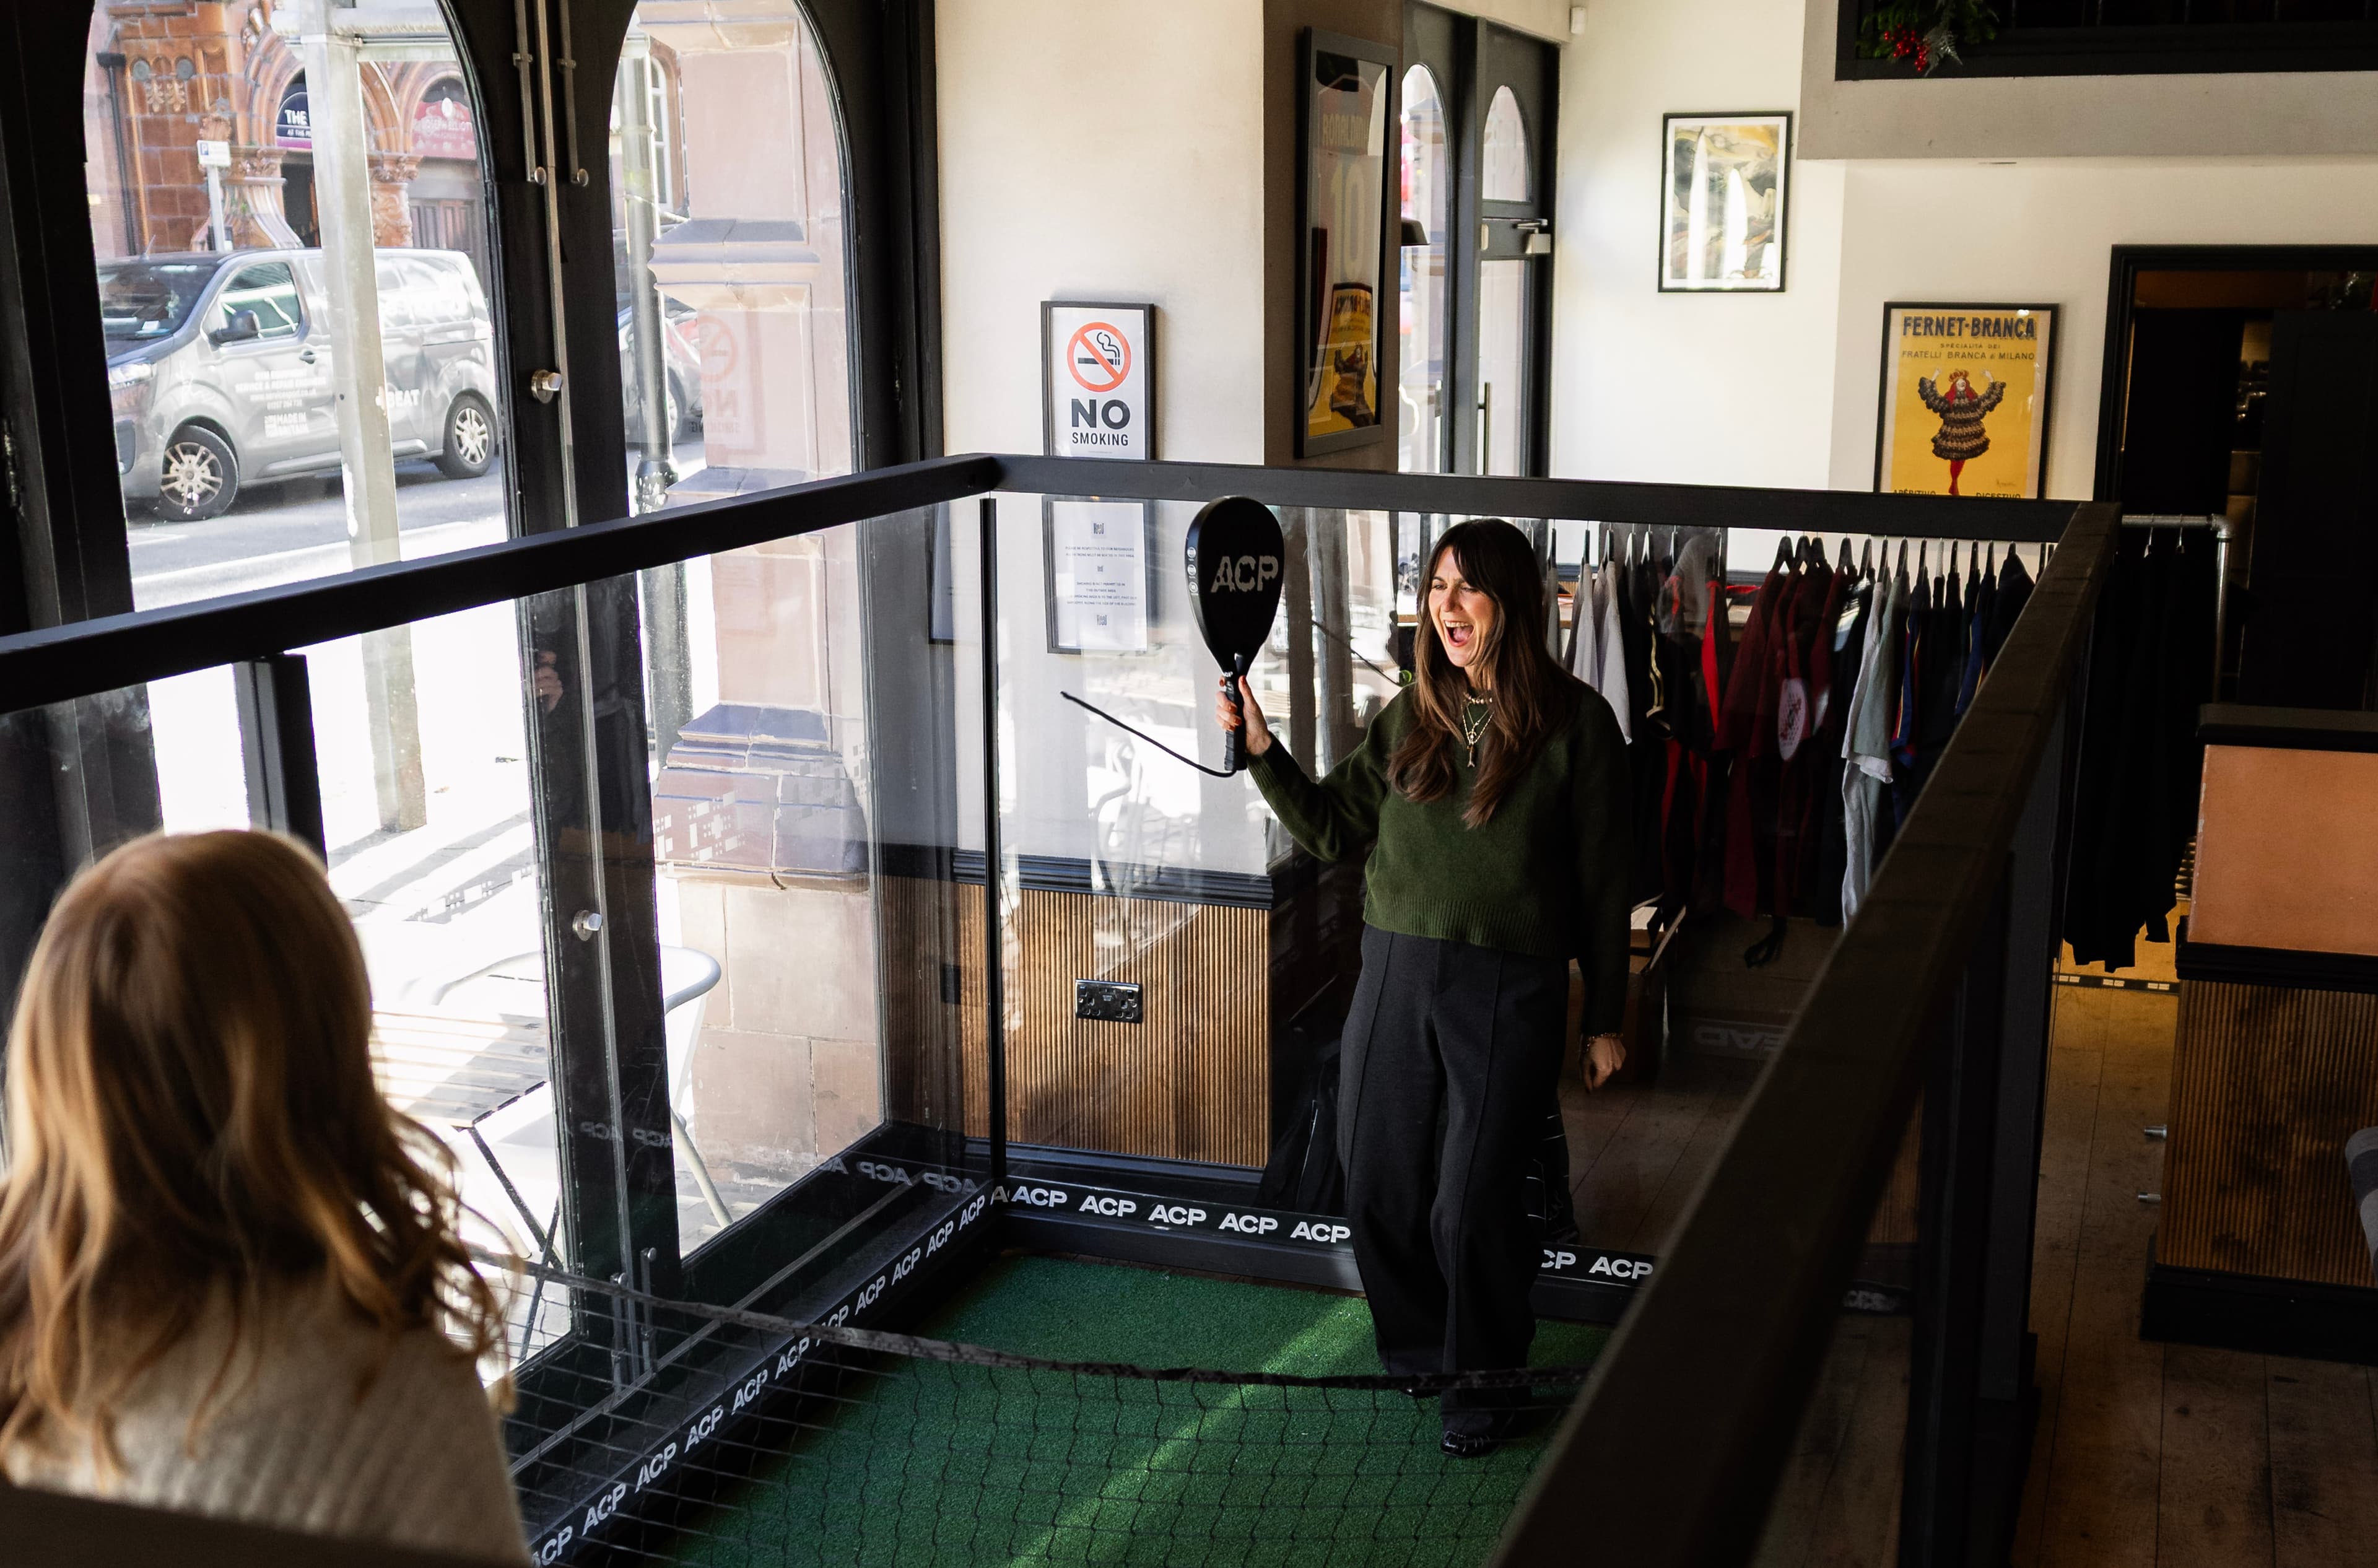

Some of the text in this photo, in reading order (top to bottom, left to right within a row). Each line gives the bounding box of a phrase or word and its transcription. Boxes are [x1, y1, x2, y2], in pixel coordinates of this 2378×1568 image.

[284, 110, 308, 126] THE
[1902, 316, 2036, 338] FERNET-BRANCA
[1902, 351, 1942, 359] FRATELLI
[1948, 352, 1987, 360] BRANCA
[277, 412, 298, 425] MADE
[1071, 398, 1131, 430] NO
[1072, 432, 1129, 447] SMOKING
[1210, 555, 1279, 593] ACP
[1011, 1185, 1068, 1208] ACP
[1078, 1195, 1137, 1217] ACP
[1148, 1204, 1206, 1226] ACP
[1218, 1213, 1278, 1235] ACP
[1289, 1221, 1351, 1244] ACP
[1541, 1249, 1577, 1270] CP
[1589, 1256, 1654, 1281] ACP
[581, 1483, 627, 1536] ACP
[635, 1442, 677, 1492] ACP
[684, 1405, 723, 1452] ACP
[731, 1369, 769, 1415] ACP
[775, 1336, 810, 1379] ACP
[855, 1275, 886, 1316] ACP
[891, 1247, 921, 1286] ACP
[926, 1221, 954, 1258] ACP
[959, 1195, 985, 1231] ACP
